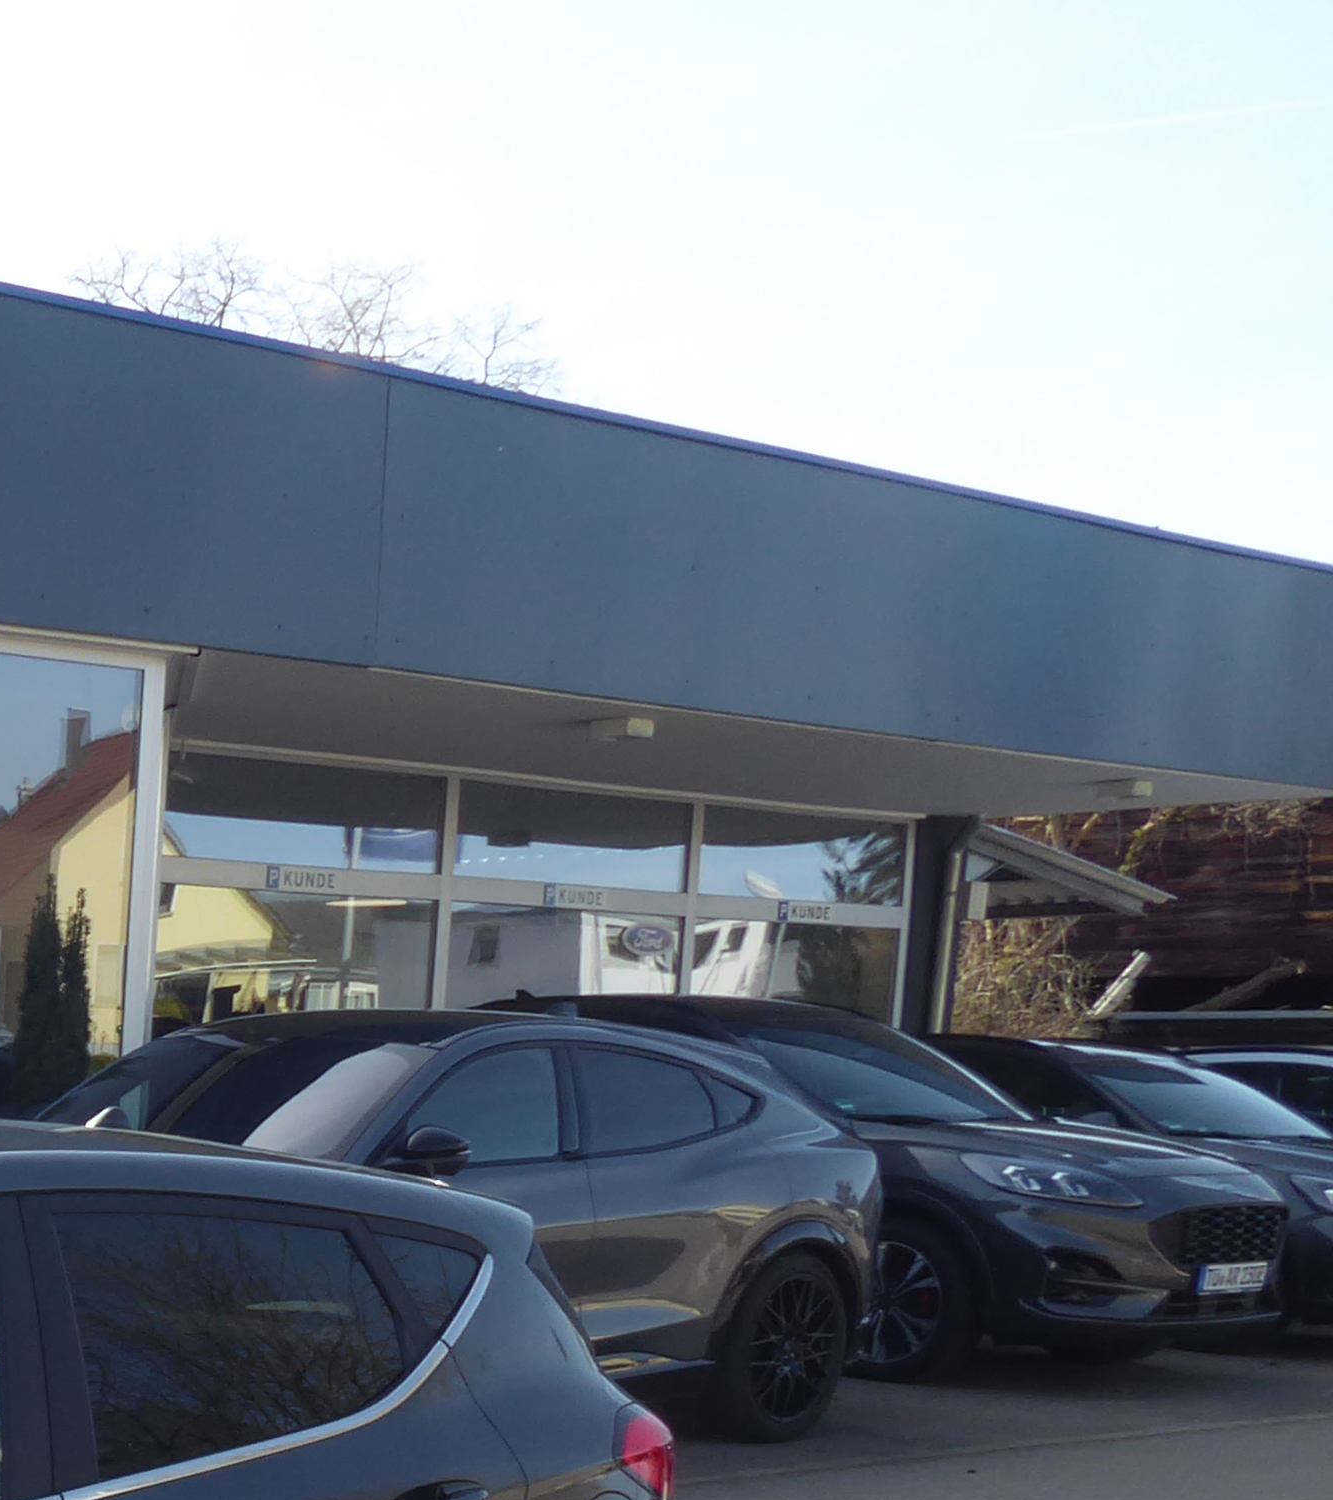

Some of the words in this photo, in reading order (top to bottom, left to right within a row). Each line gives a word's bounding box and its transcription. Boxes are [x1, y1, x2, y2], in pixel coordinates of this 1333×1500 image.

[283, 870, 336, 889] KUNDE
[558, 888, 604, 907] KUNDE
[790, 904, 832, 921] KUNDE
